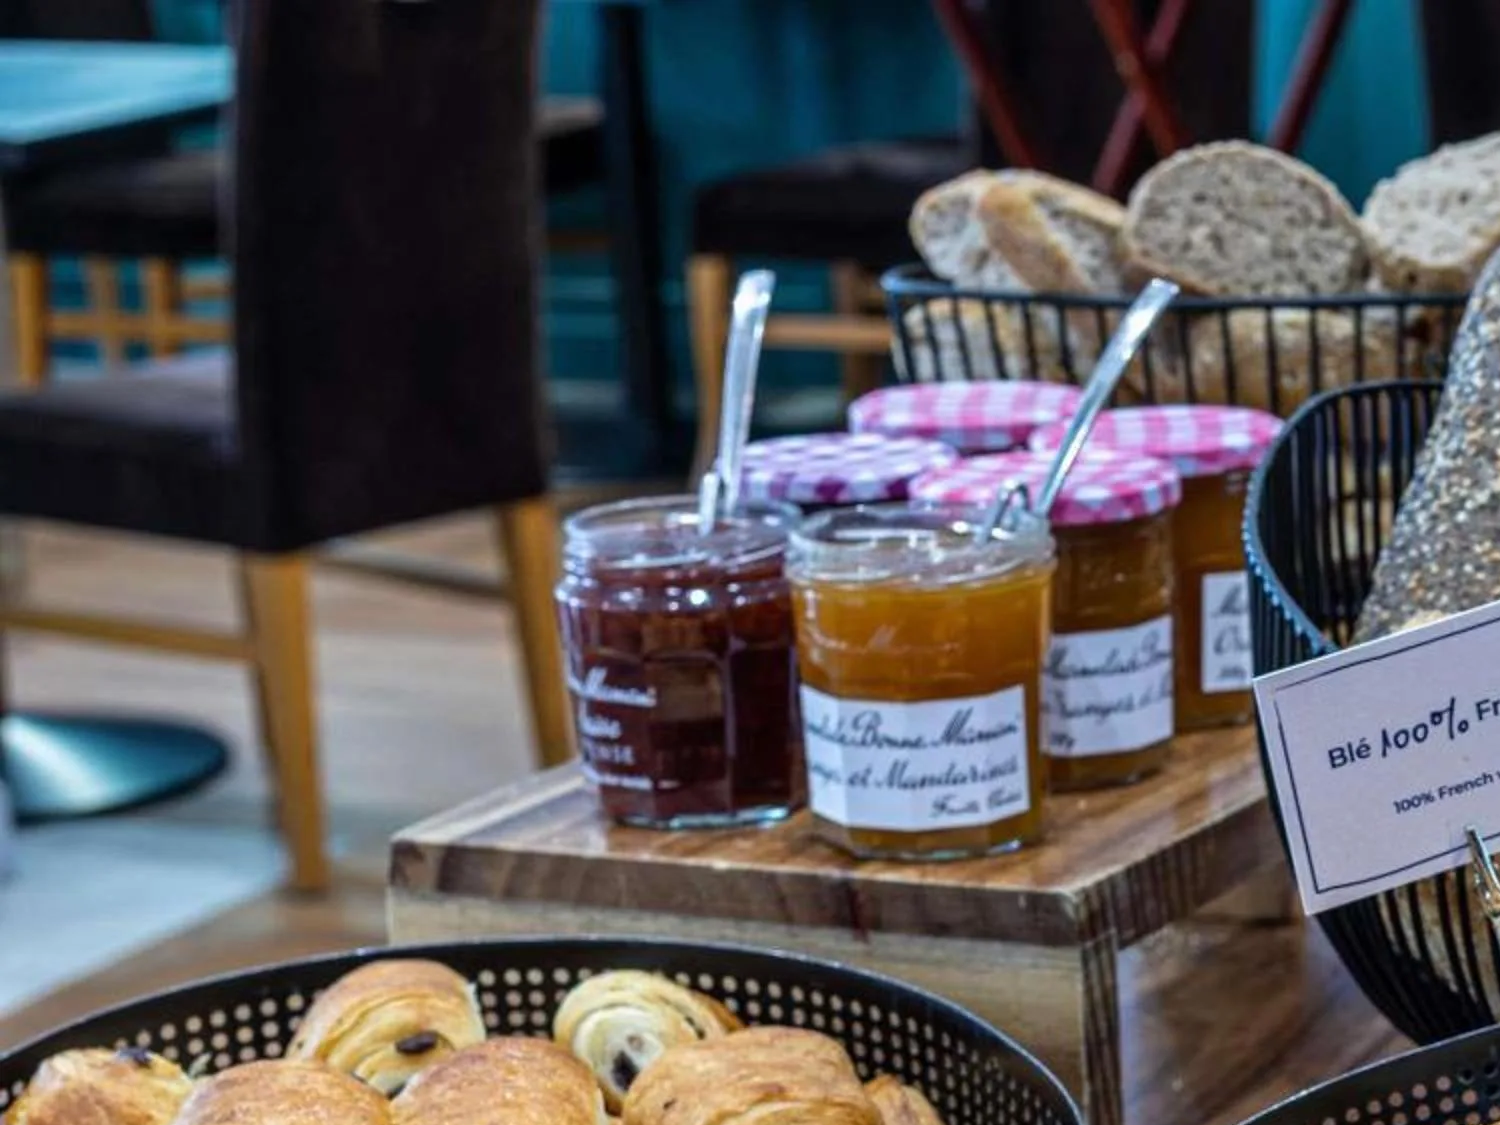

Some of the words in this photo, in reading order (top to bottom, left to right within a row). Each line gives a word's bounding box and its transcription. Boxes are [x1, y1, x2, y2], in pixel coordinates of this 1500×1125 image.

[852, 710, 927, 750] Bonne
[1327, 734, 1372, 769] Blé
[1379, 696, 1470, 758] 100%
[1392, 791, 1436, 814] 100%
[1438, 770, 1495, 800] French
